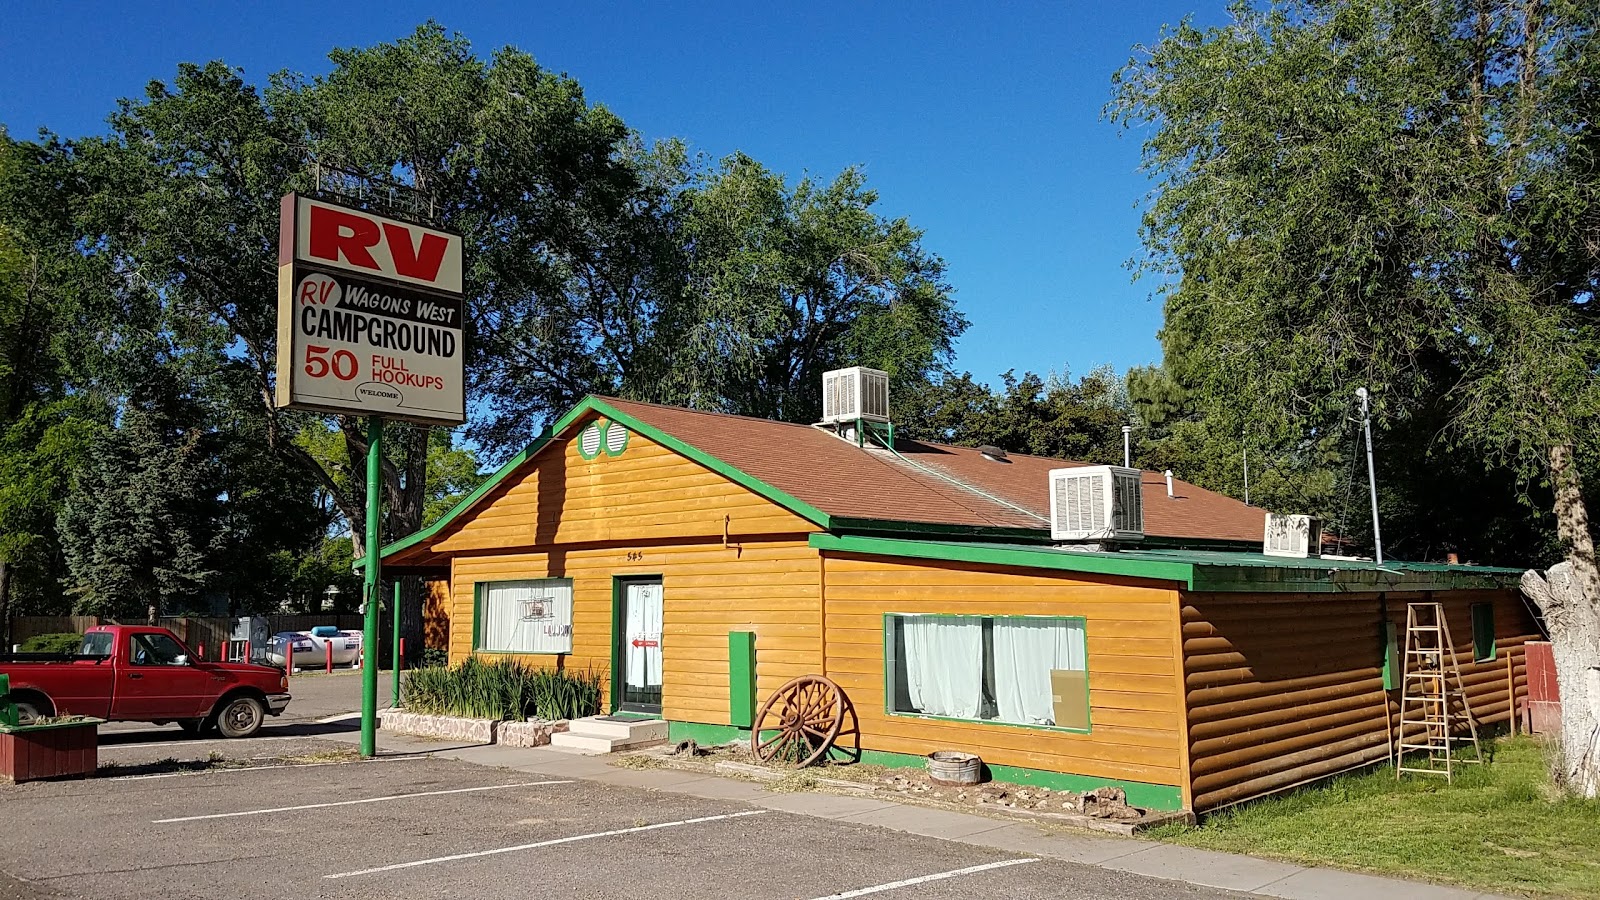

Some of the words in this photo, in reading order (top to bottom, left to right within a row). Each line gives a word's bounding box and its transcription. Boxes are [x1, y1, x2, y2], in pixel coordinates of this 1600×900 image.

[309, 204, 450, 283] RV
[300, 280, 336, 307] RV
[345, 284, 411, 315] WAGONS
[416, 300, 456, 324] WEST
[301, 305, 456, 358] CAMPGROUND
[304, 344, 359, 381] 50
[371, 354, 410, 373] FULL
[371, 369, 444, 390] HOOKUPS
[360, 389, 399, 400] WELCOME
